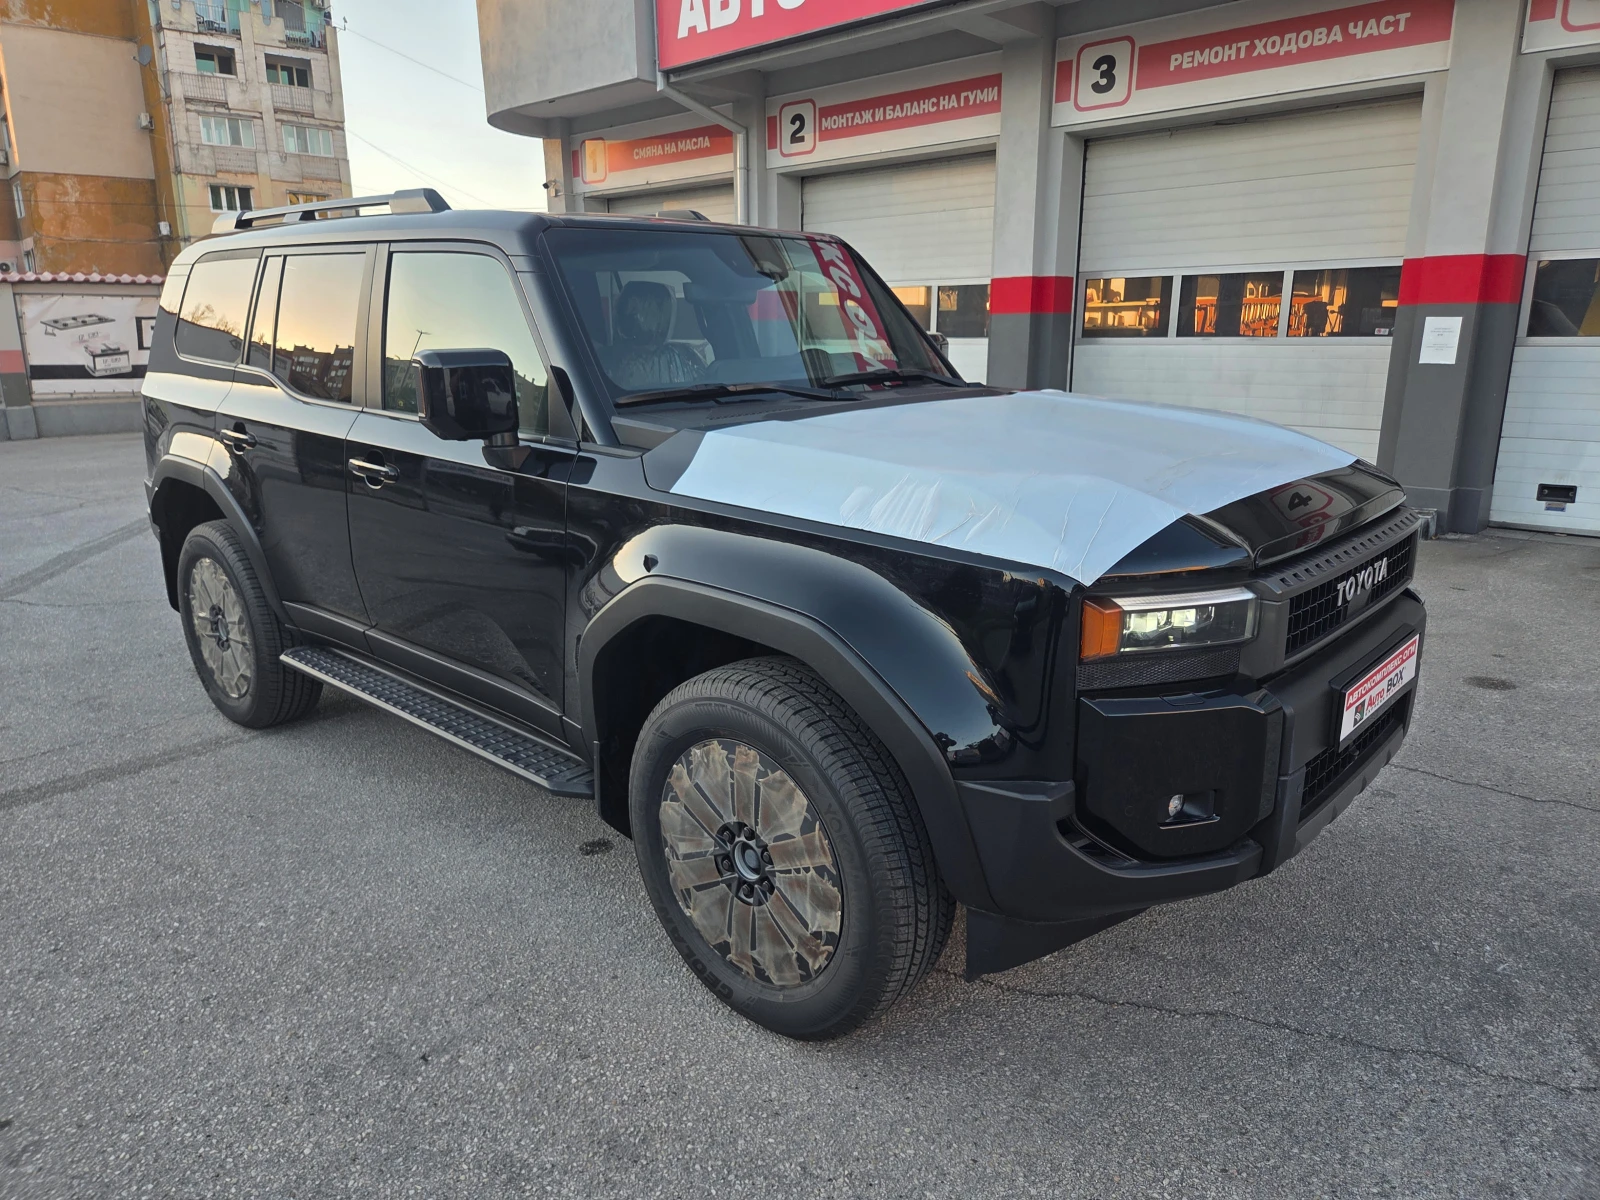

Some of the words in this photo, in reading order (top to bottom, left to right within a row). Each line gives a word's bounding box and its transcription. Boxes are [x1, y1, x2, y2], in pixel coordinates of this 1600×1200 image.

[677, 0, 806, 39] АВ
[1169, 41, 1250, 71] РЕМОНТ
[1251, 25, 1343, 57] ХОДОВА
[1347, 12, 1411, 39] ЧАСТ
[1090, 54, 1117, 94] 3
[821, 108, 873, 131] МОНТАЖ
[875, 107, 884, 122] И
[885, 97, 938, 120] БАЛАНС
[939, 95, 958, 111] НА
[960, 86, 999, 107] ГУМИ
[633, 144, 663, 160] СМЯНА
[664, 143, 677, 154] НА
[677, 135, 711, 152] МАСЛА
[789, 113, 806, 144] 2
[588, 148, 598, 173] 1
[1336, 556, 1388, 607] TOYOTA
[1347, 654, 1403, 706] АВТОКОМПЛЕКС
[1386, 667, 1405, 693] BOX
